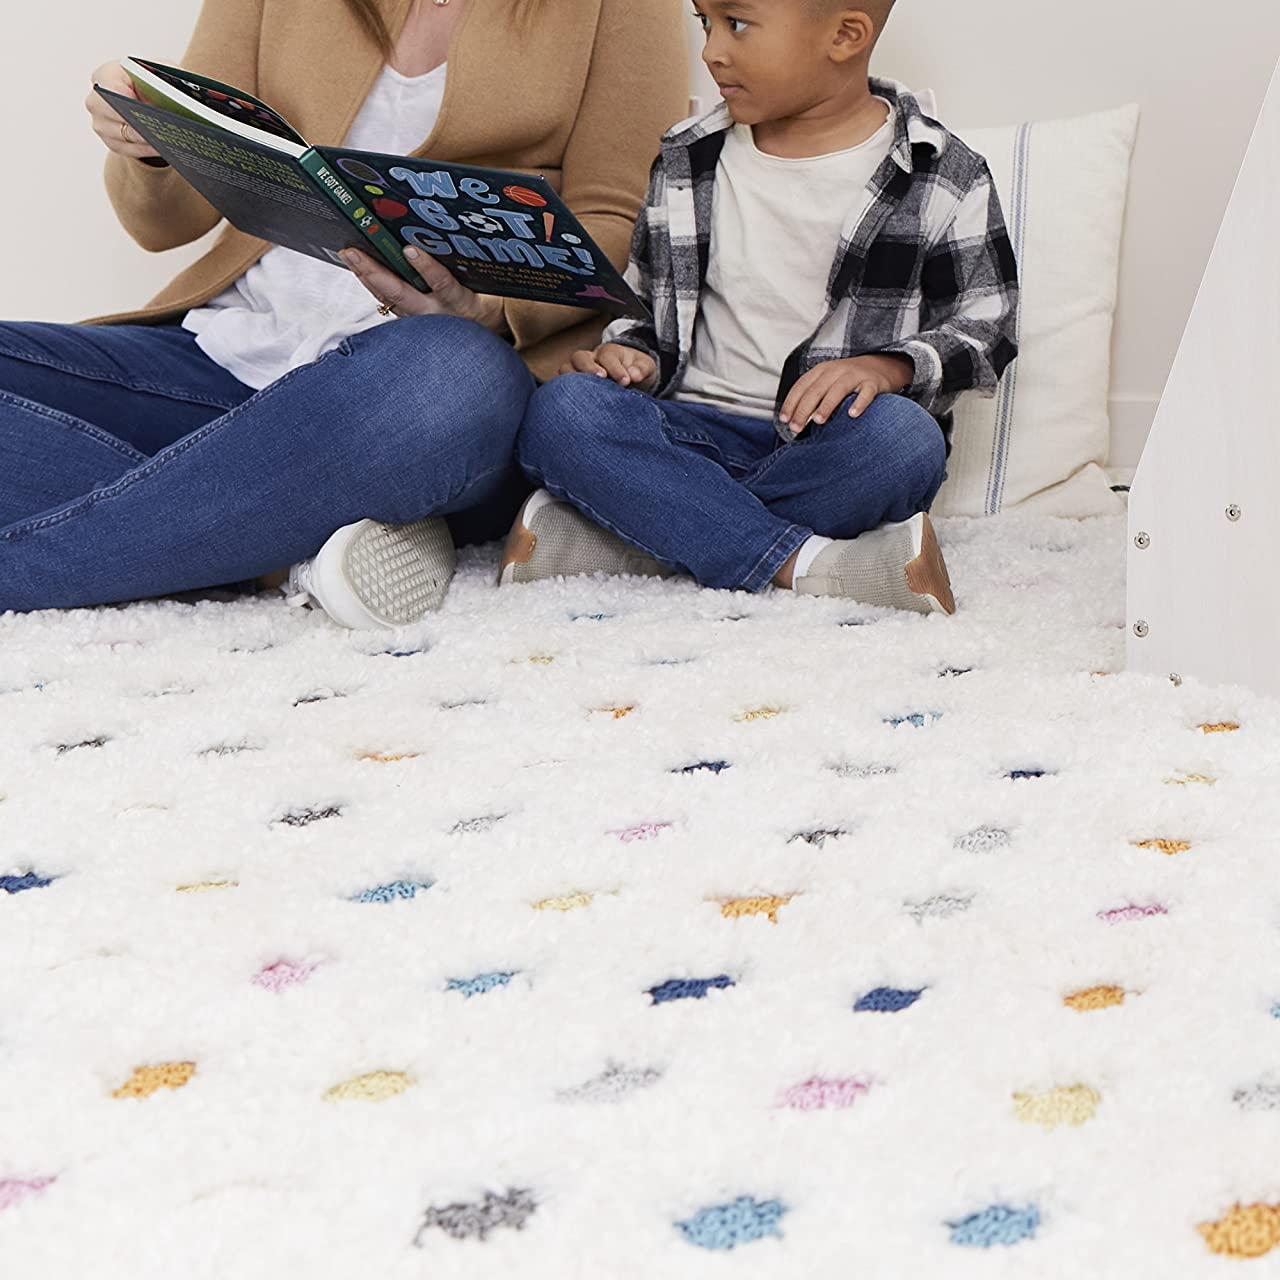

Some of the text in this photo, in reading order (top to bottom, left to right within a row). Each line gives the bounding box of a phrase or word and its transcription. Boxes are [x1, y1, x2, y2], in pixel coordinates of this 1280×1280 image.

[316, 166, 330, 180] WE
[324, 175, 339, 190] GOT
[400, 225, 596, 276] GAME!
